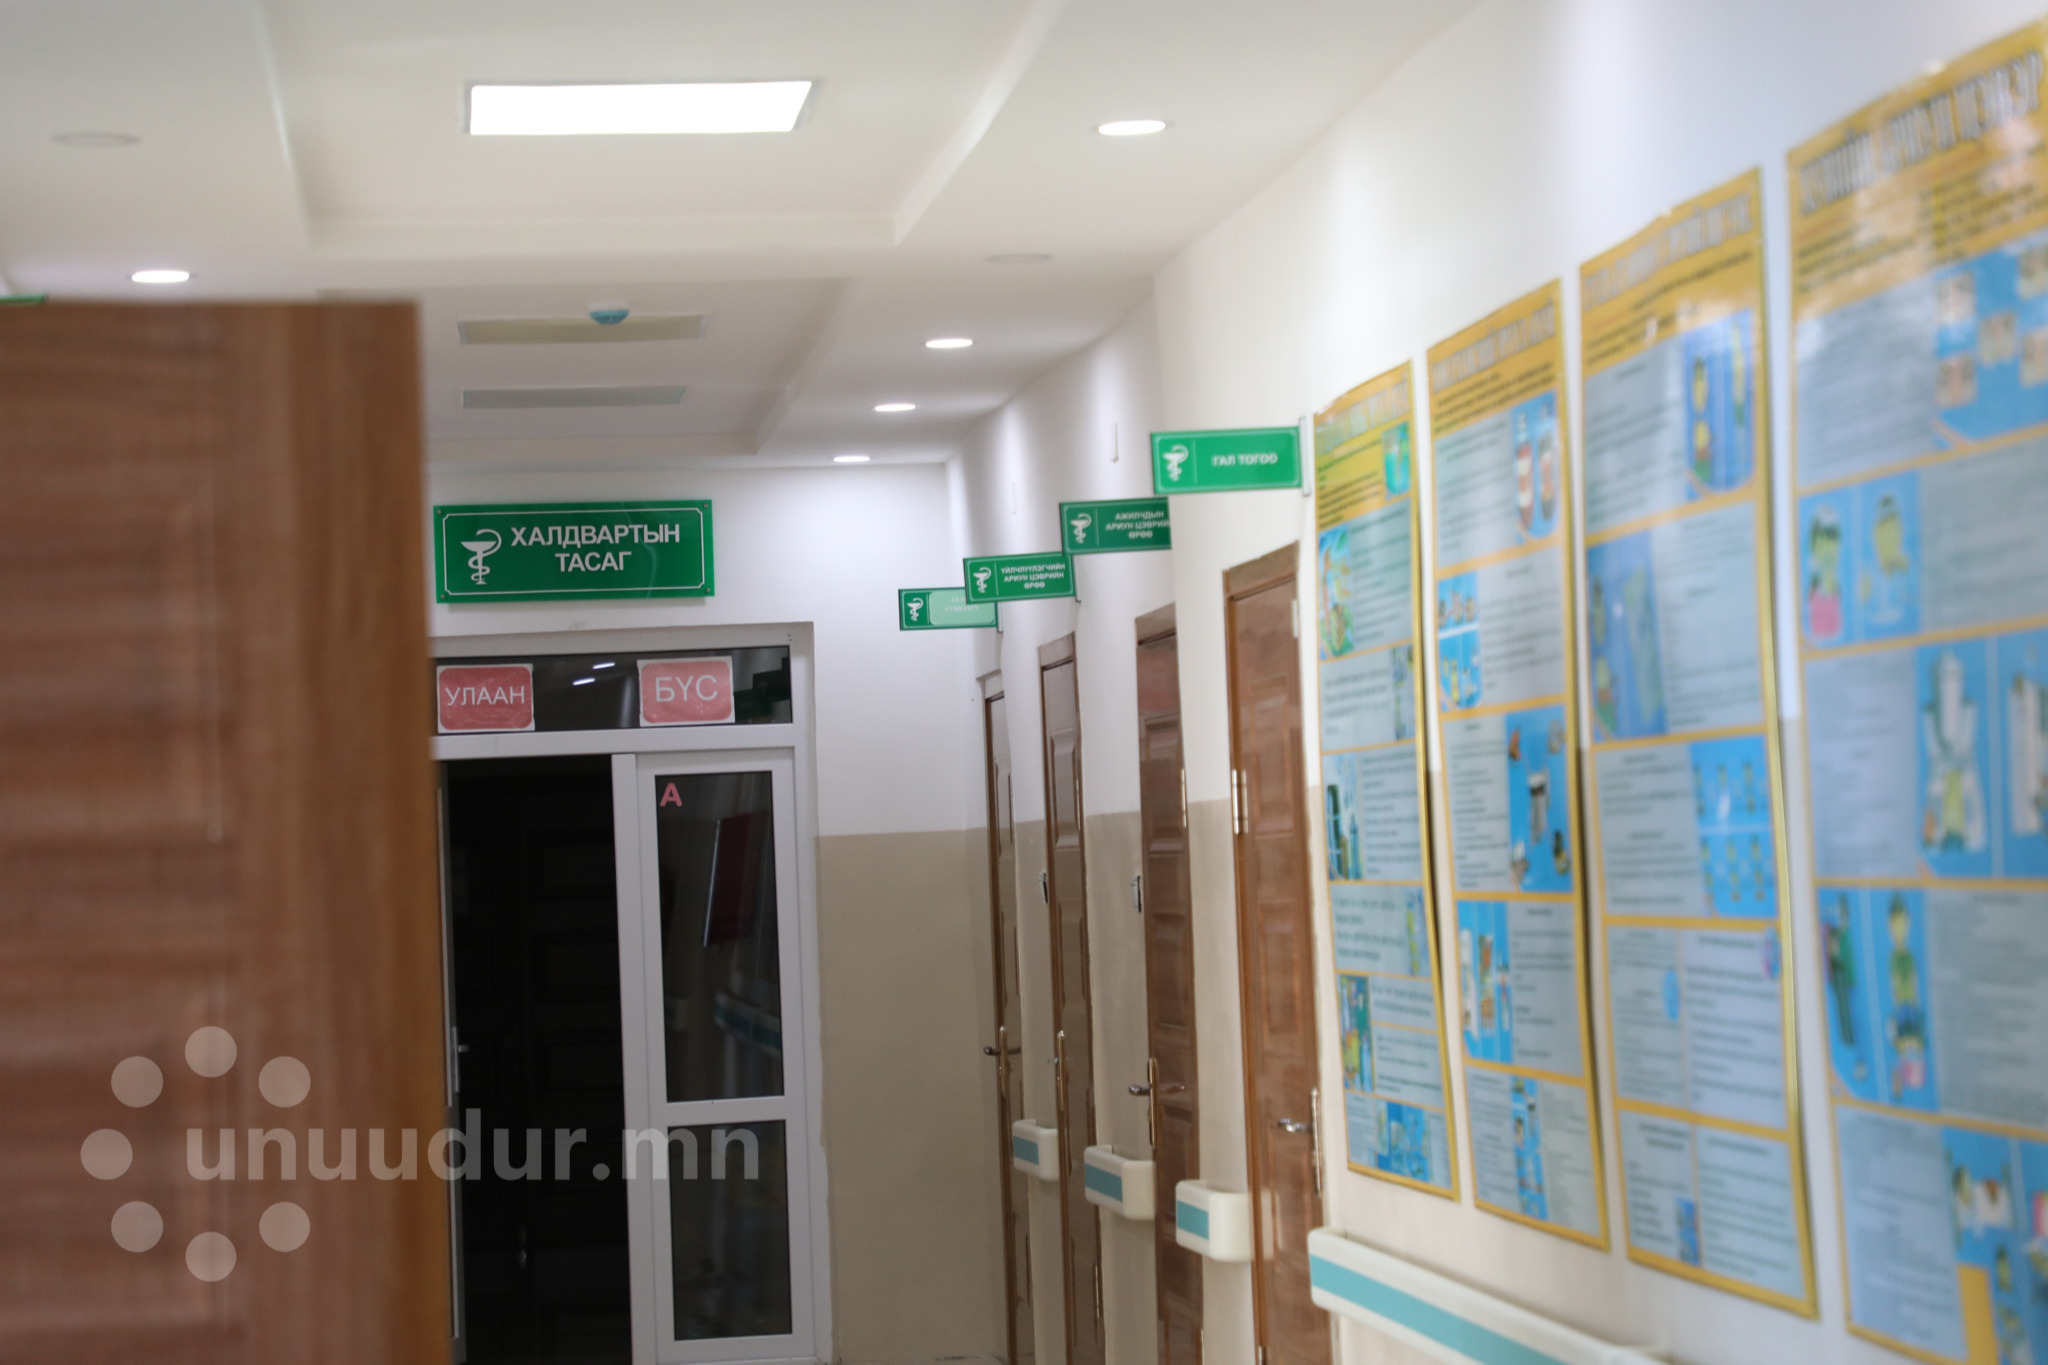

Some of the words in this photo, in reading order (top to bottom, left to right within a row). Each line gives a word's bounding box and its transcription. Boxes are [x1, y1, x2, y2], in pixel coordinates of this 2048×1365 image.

[1212, 454, 1236, 466] ГАЛ
[1238, 452, 1278, 465] ТОГОО
[1115, 511, 1164, 521] АЖИЛЧДЫН
[1106, 522, 1133, 530] АРИУН
[1135, 519, 1170, 530] ЦЭВРИЙ
[511, 524, 680, 549] ХАЛДВАРТЫН
[555, 551, 632, 573] ТАСАГ
[1004, 573, 1028, 582] АРИУН
[1029, 571, 1064, 580] ЦЭВРИЙН
[445, 686, 525, 706] УЛААН
[655, 674, 718, 702] БҮС
